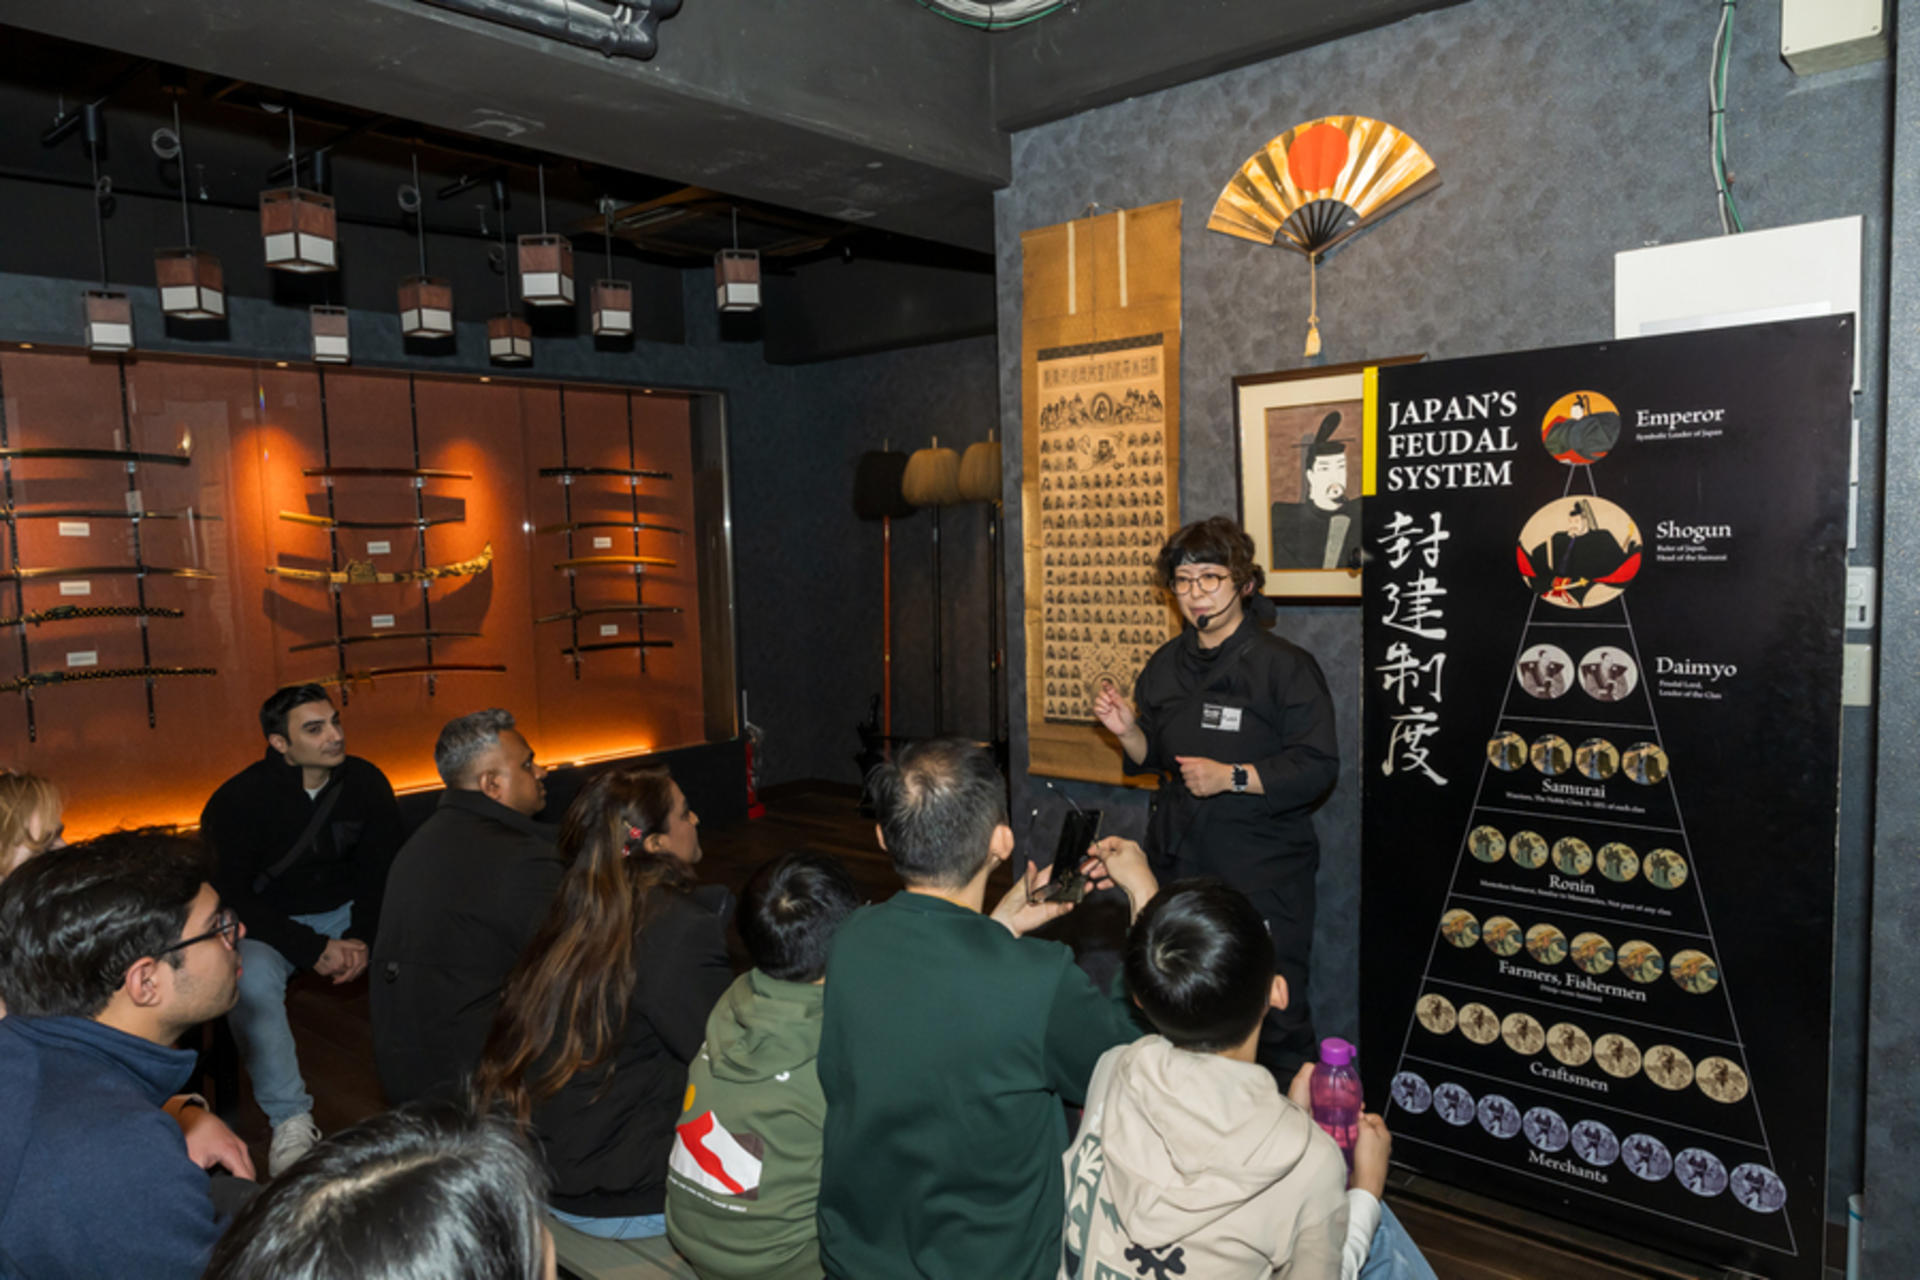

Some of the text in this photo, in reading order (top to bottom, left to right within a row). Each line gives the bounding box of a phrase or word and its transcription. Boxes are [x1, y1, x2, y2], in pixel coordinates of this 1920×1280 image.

[1388, 390, 1518, 431] JAPAN'S
[1636, 408, 1725, 430] Emperor
[1388, 425, 1518, 459] FEUDAL
[1703, 429, 1723, 438] Japan
[1387, 460, 1513, 492] SYSTEM
[1656, 520, 1732, 544] Shogun
[1375, 510, 1451, 786] 封建制度
[1656, 656, 1738, 682] Daimyo
[1542, 778, 1606, 798] Samurai
[1549, 874, 1595, 894] Ronin
[1499, 959, 1562, 987] Farmers,
[1565, 972, 1648, 1003] Fishermen
[1529, 1061, 1609, 1093] Craftsmen
[1528, 1149, 1609, 1185] Merchants
